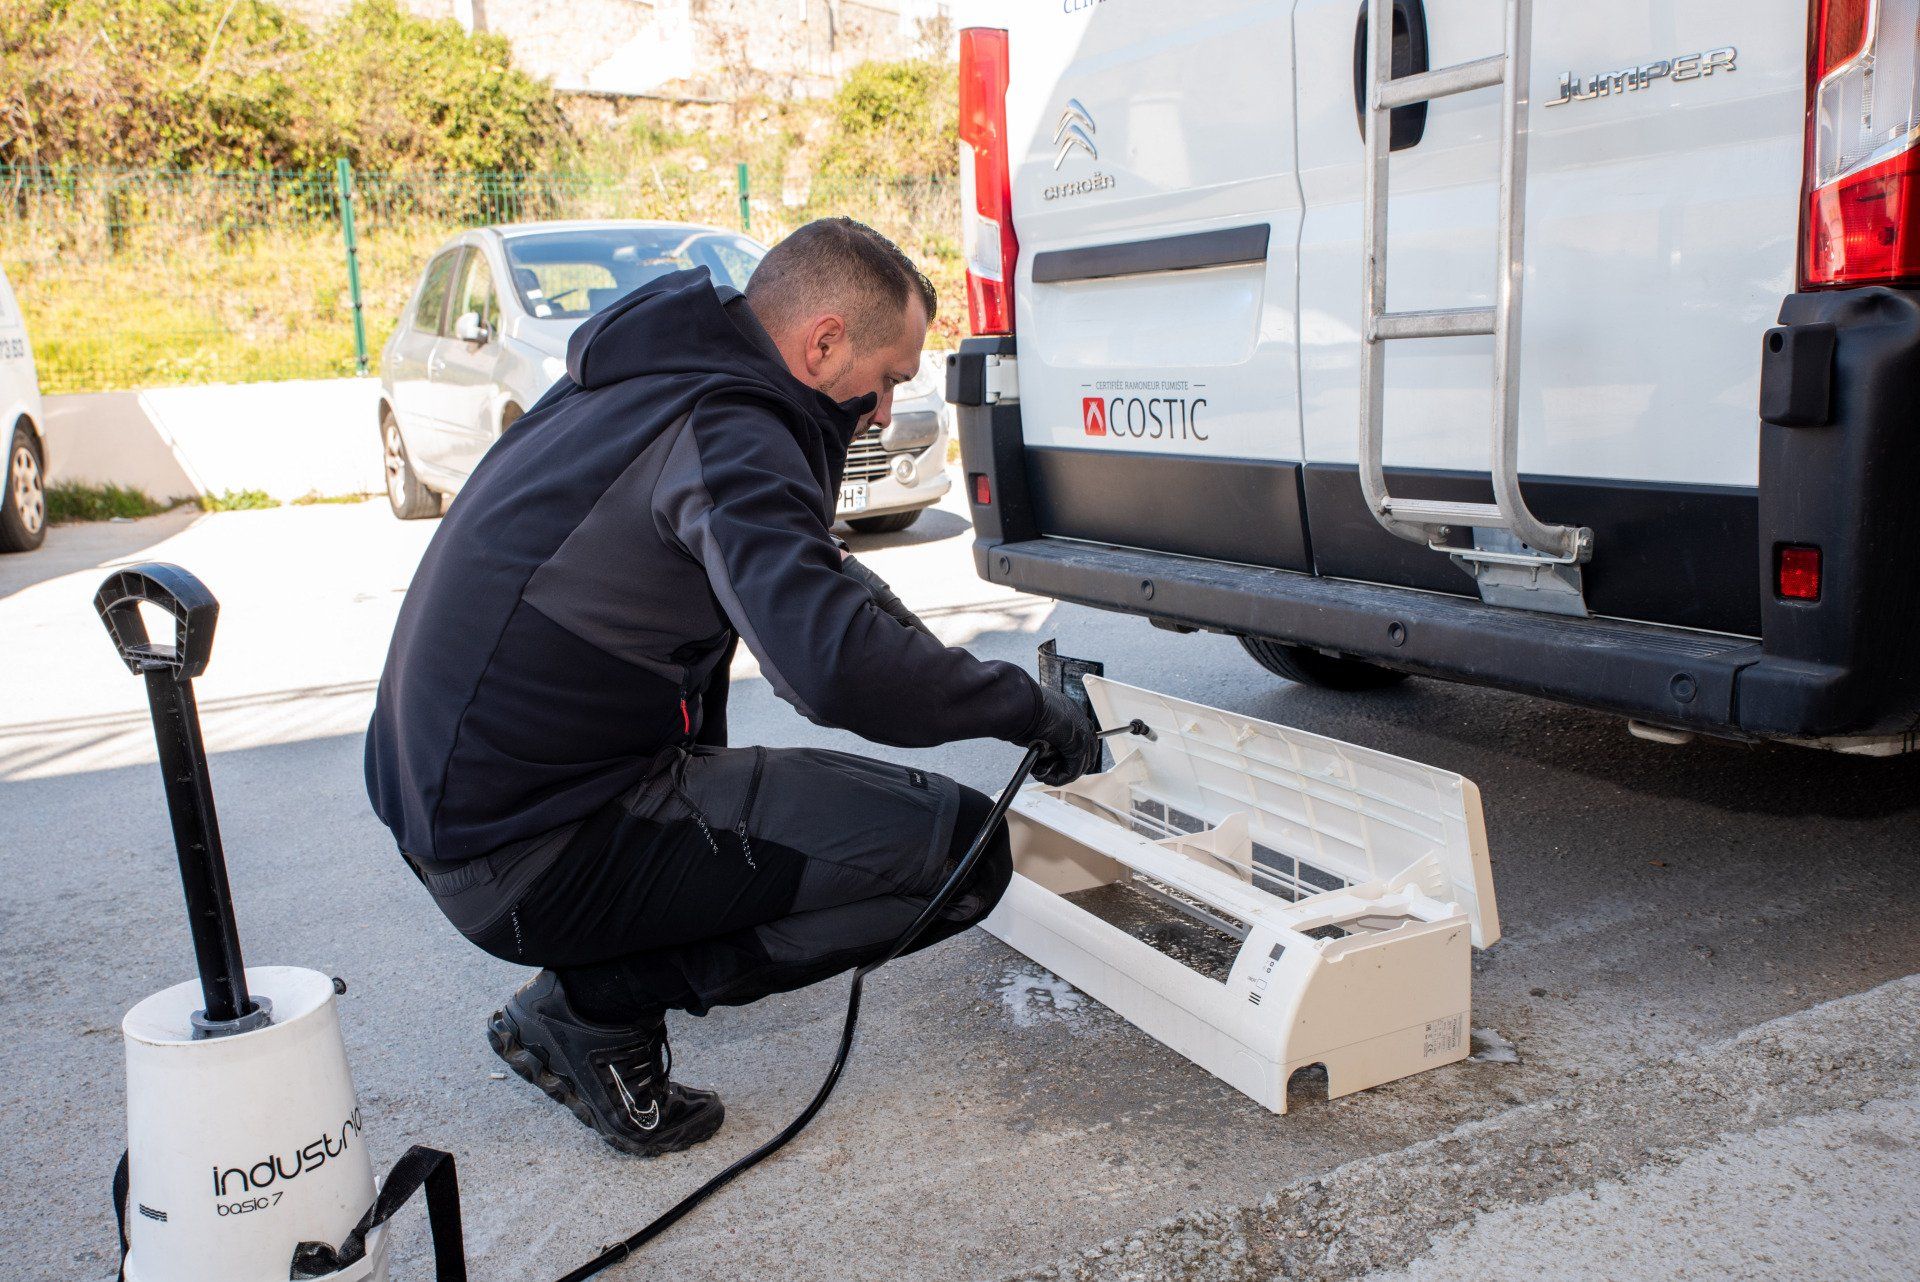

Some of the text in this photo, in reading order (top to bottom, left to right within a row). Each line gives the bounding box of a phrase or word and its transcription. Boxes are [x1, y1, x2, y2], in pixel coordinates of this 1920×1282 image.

[1544, 46, 1737, 107] JUMPER
[1095, 380, 1189, 390] CERTIFIÉE RAMONEUR FUMISTE
[1109, 397, 1209, 441] COSTIC
[217, 1191, 284, 1217] basic 7
